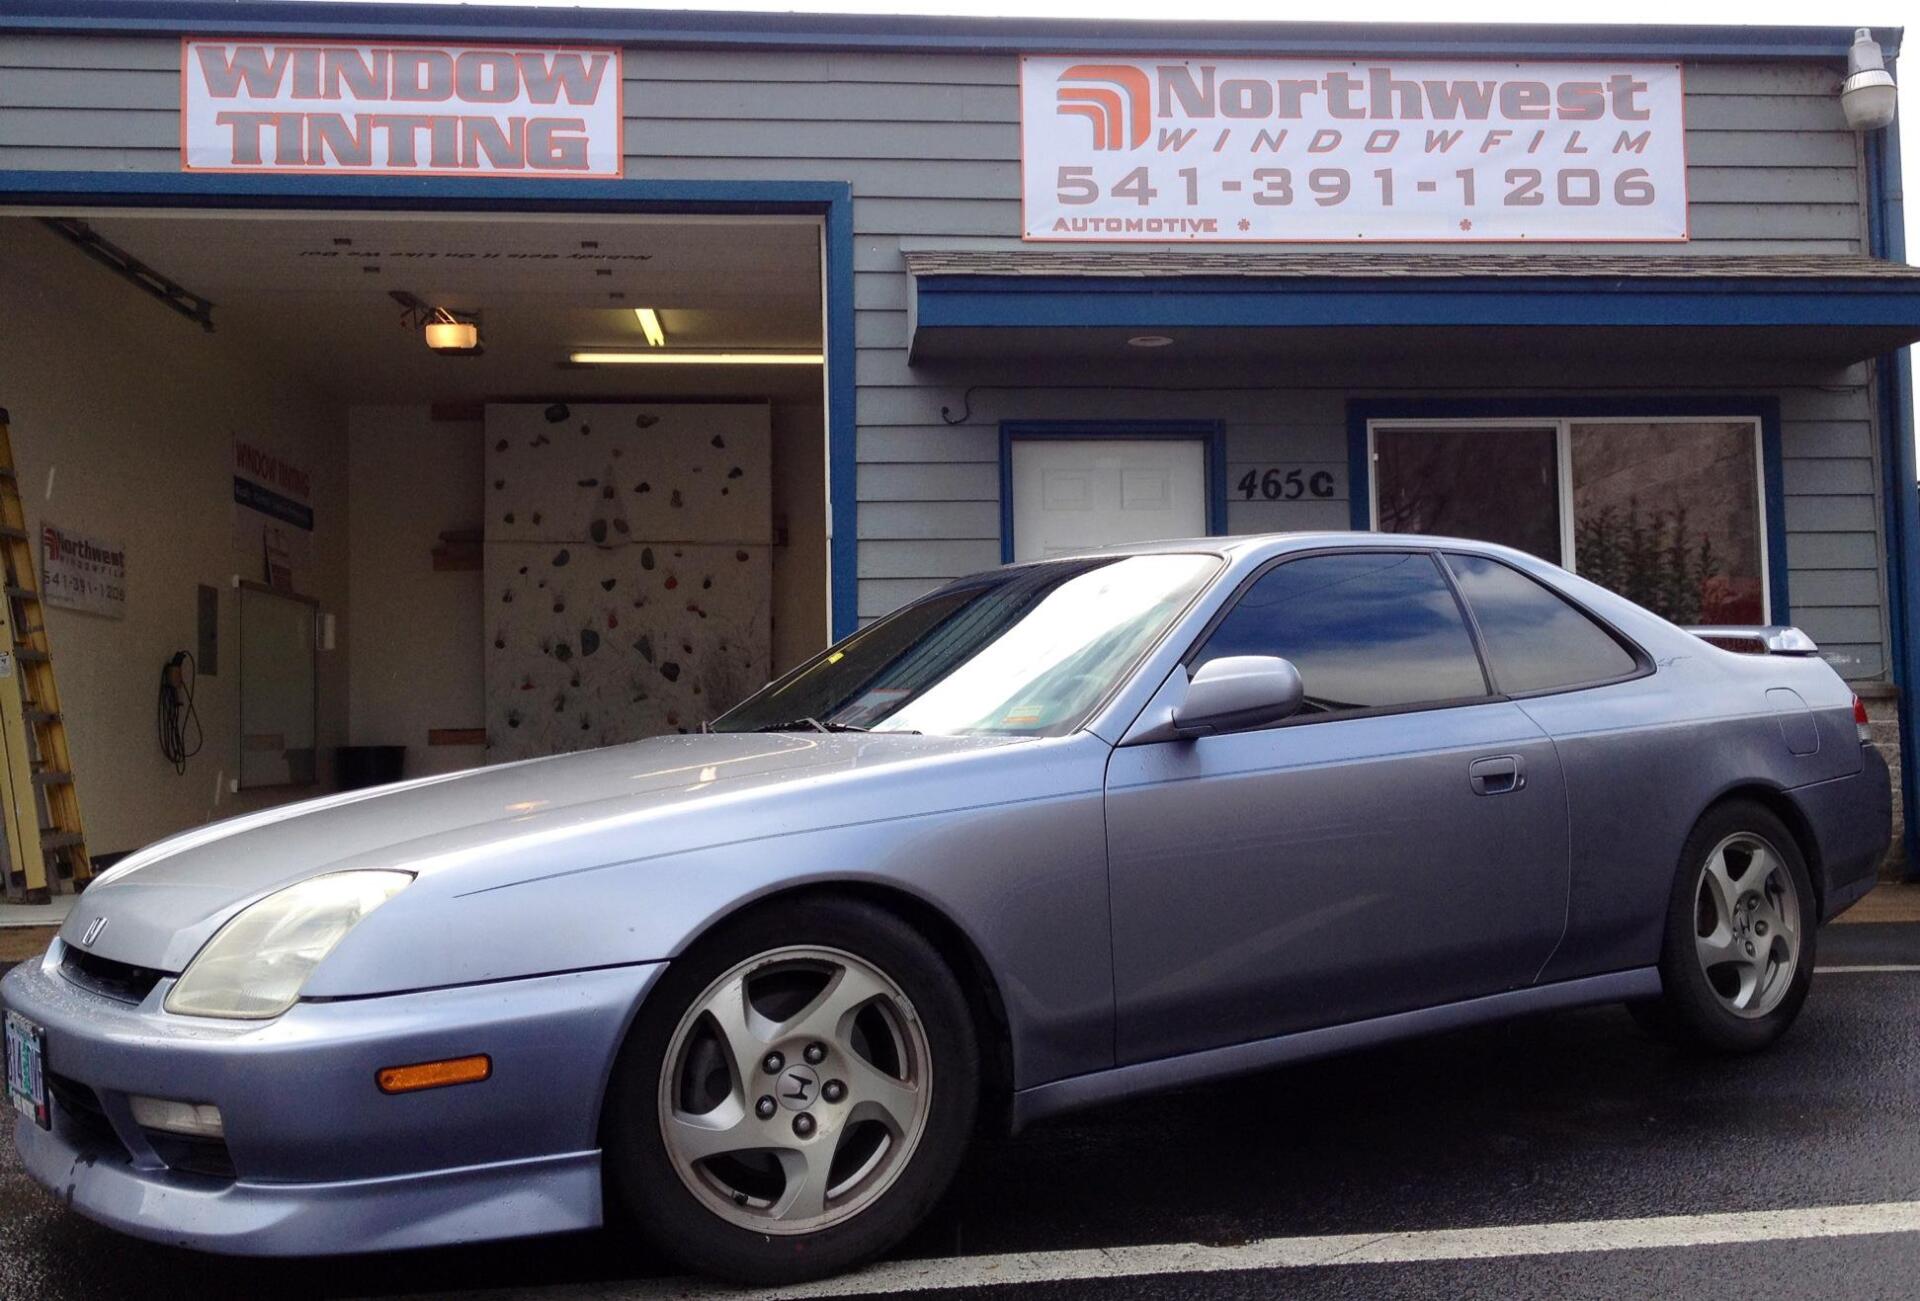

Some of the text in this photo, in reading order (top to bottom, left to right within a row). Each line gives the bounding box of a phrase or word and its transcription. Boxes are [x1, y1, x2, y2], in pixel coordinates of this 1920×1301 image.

[195, 45, 610, 105] WINDOW
[1156, 65, 1651, 121] Northwest
[215, 111, 590, 170] TINTING
[1056, 165, 1656, 208] 541-391-1206
[1051, 217, 1218, 233] AUTOMOTIVE
